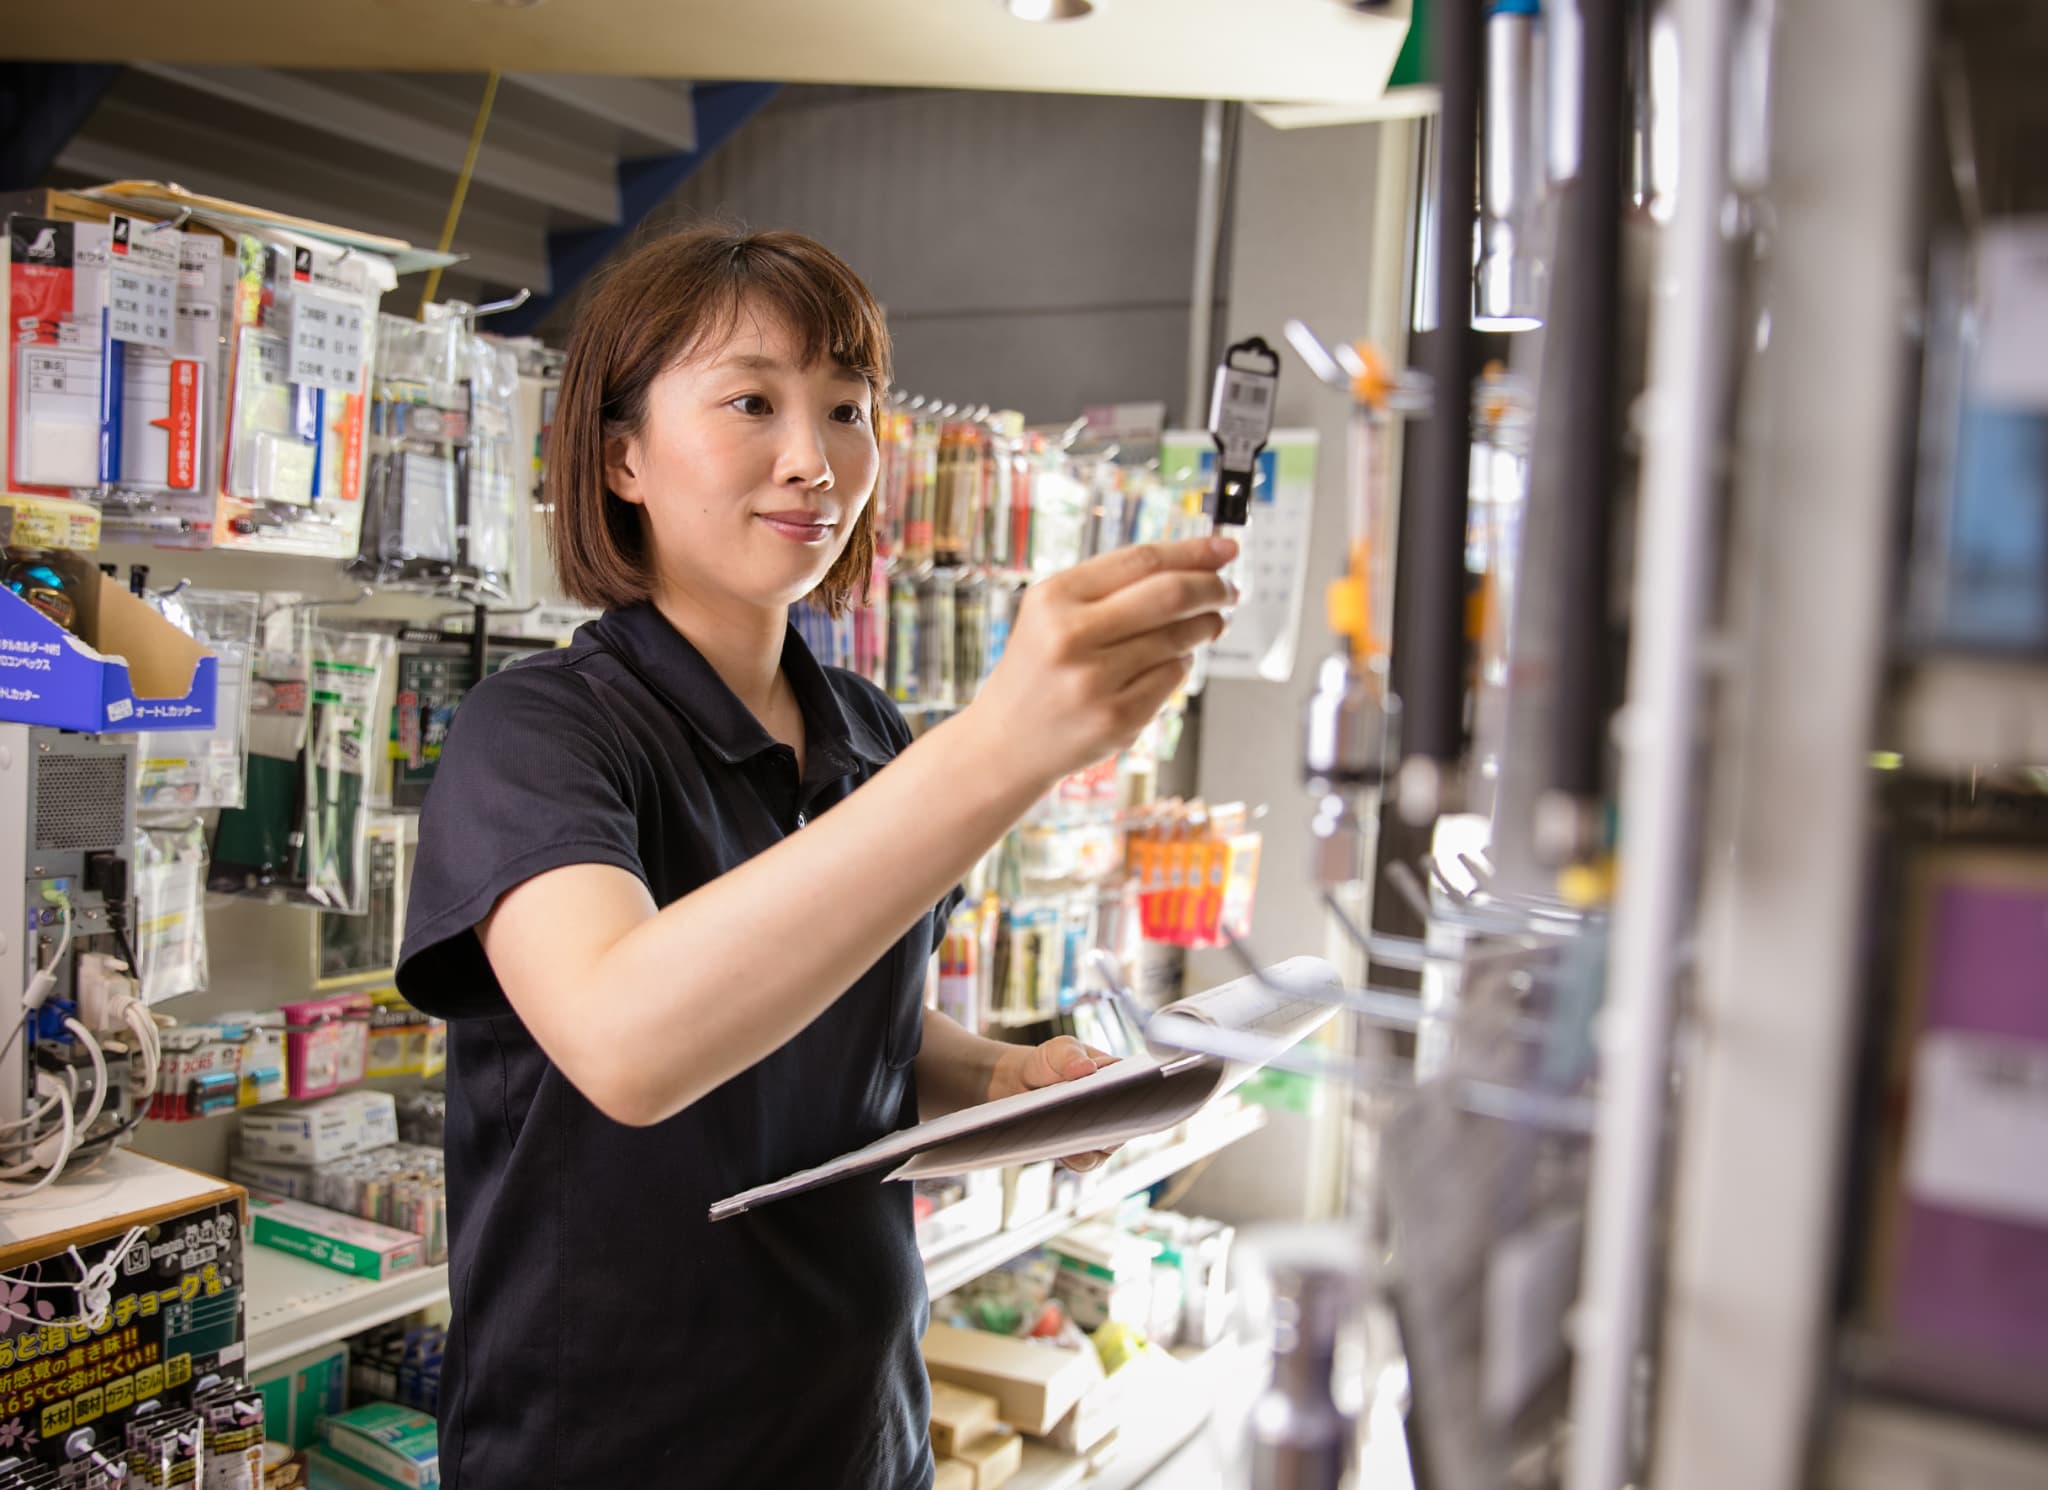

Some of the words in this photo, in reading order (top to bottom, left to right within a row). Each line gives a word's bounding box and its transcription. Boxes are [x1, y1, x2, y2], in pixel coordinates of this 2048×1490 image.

[135, 705, 202, 718] オートLカッター
[105, 1381, 135, 1403] ガラス
[43, 1409, 71, 1430] 木材
